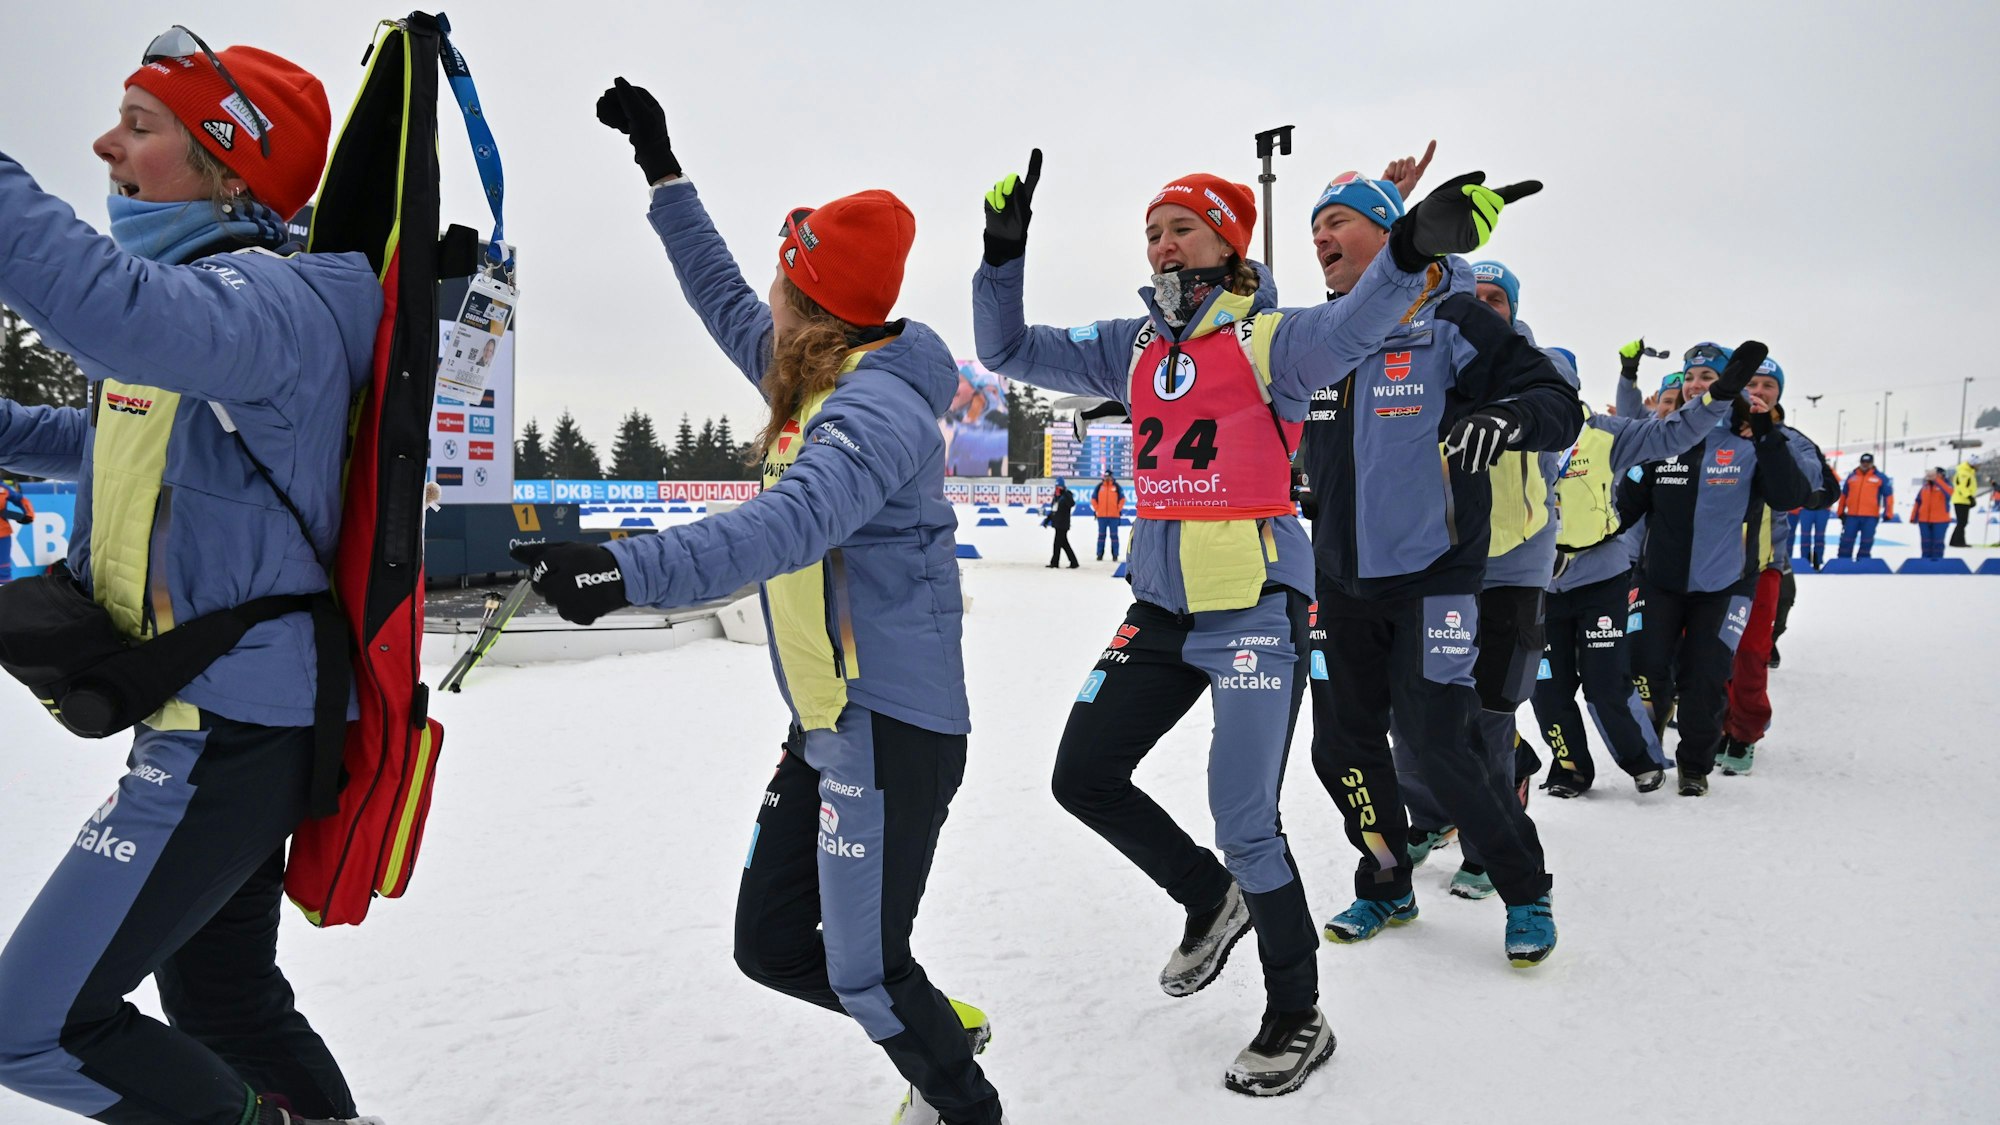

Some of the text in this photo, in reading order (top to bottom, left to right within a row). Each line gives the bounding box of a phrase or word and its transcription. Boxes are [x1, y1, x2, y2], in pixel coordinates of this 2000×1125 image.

[203, 122, 232, 149] adidas
[289, 224, 308, 236] IBU
[1373, 384, 1424, 397] WÜRTH
[473, 417, 490, 427] DKB
[556, 485, 592, 499] DKB
[608, 485, 645, 499] DKB
[521, 506, 529, 525] 1
[1428, 627, 1471, 640] tectake
[1586, 628, 1623, 639] tectake
[1239, 636, 1281, 646] TERREX
[1441, 646, 1470, 654] TERREX
[1218, 672, 1282, 690] tectake
[1548, 723, 1569, 759] GER
[826, 779, 864, 798] TERREX
[1341, 767, 1377, 829] GER
